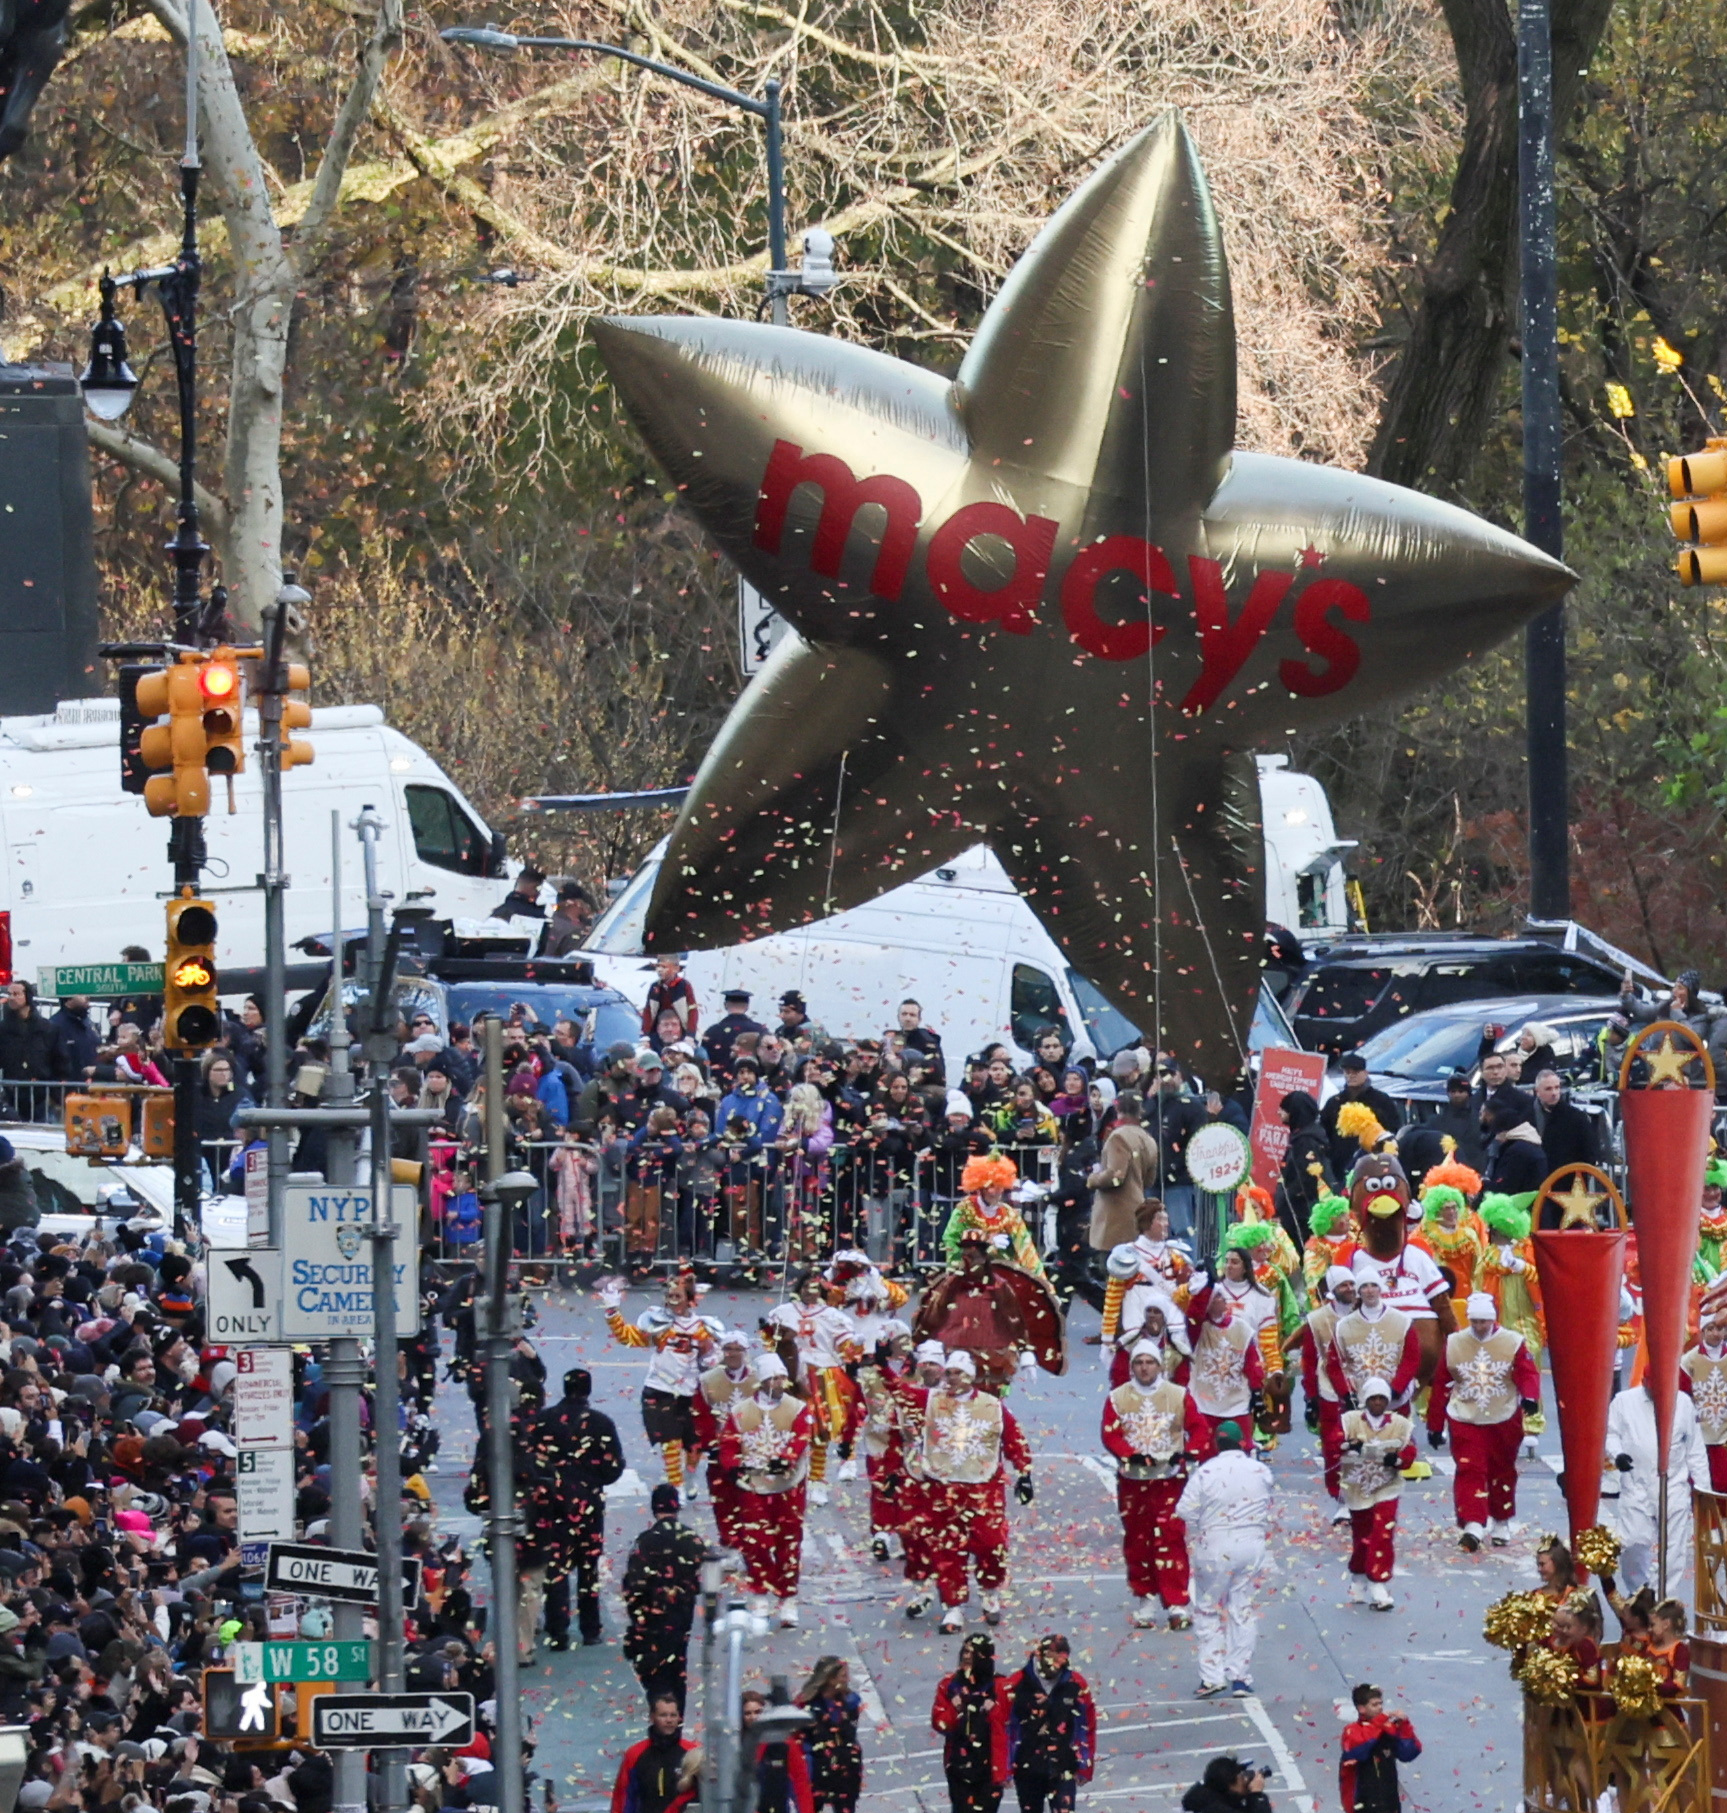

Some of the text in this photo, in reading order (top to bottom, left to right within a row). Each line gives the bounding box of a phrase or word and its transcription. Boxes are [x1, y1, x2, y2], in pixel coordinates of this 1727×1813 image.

[57, 965, 164, 985] CENTRAL PARK
[1209, 1159, 1242, 1180] 1924
[216, 1315, 272, 1333] ONLY
[240, 1353, 251, 1373] 3
[242, 1452, 253, 1472] 5
[290, 1561, 379, 1588] ONE WA
[269, 1648, 293, 1677] W
[307, 1647, 339, 1676] 58
[328, 1710, 450, 1731] ONE WAY
